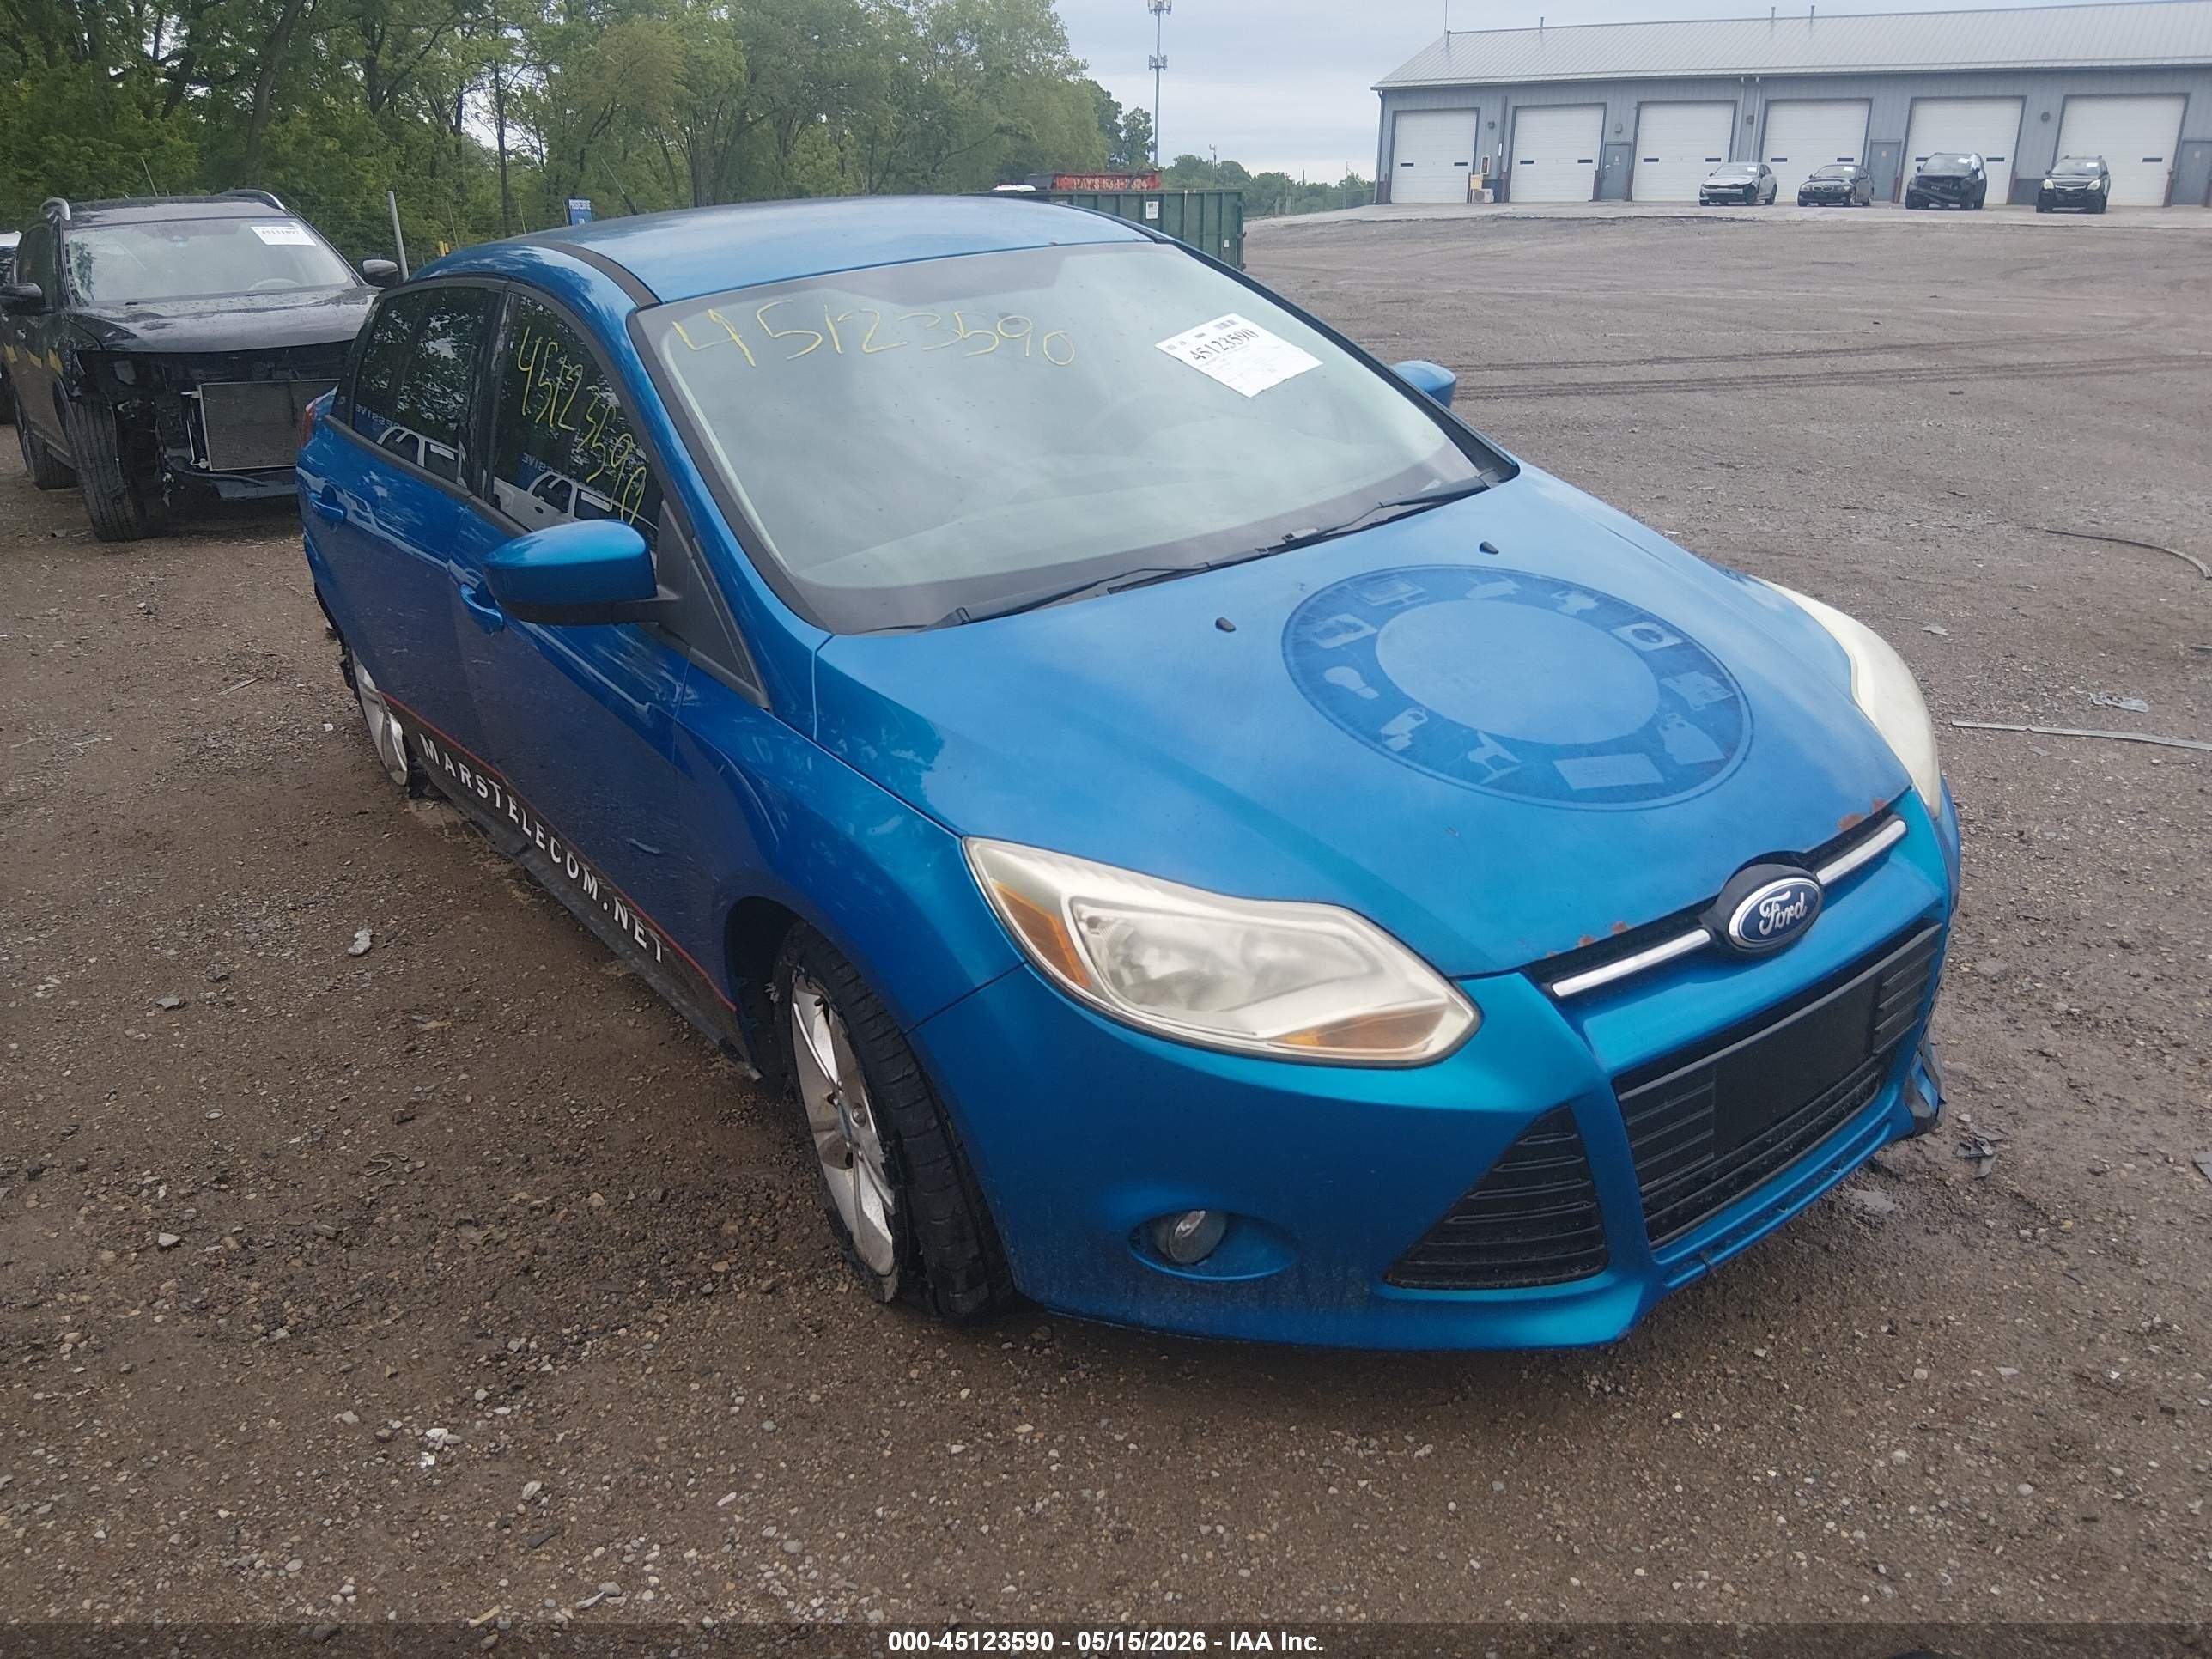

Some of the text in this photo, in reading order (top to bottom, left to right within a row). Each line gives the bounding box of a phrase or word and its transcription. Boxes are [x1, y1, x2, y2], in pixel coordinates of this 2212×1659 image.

[672, 300, 1077, 368] 45123590
[1190, 328, 1260, 362] 45123590
[419, 733, 669, 963] MARSTELECOM.NET
[1759, 890, 1808, 936] Ford
